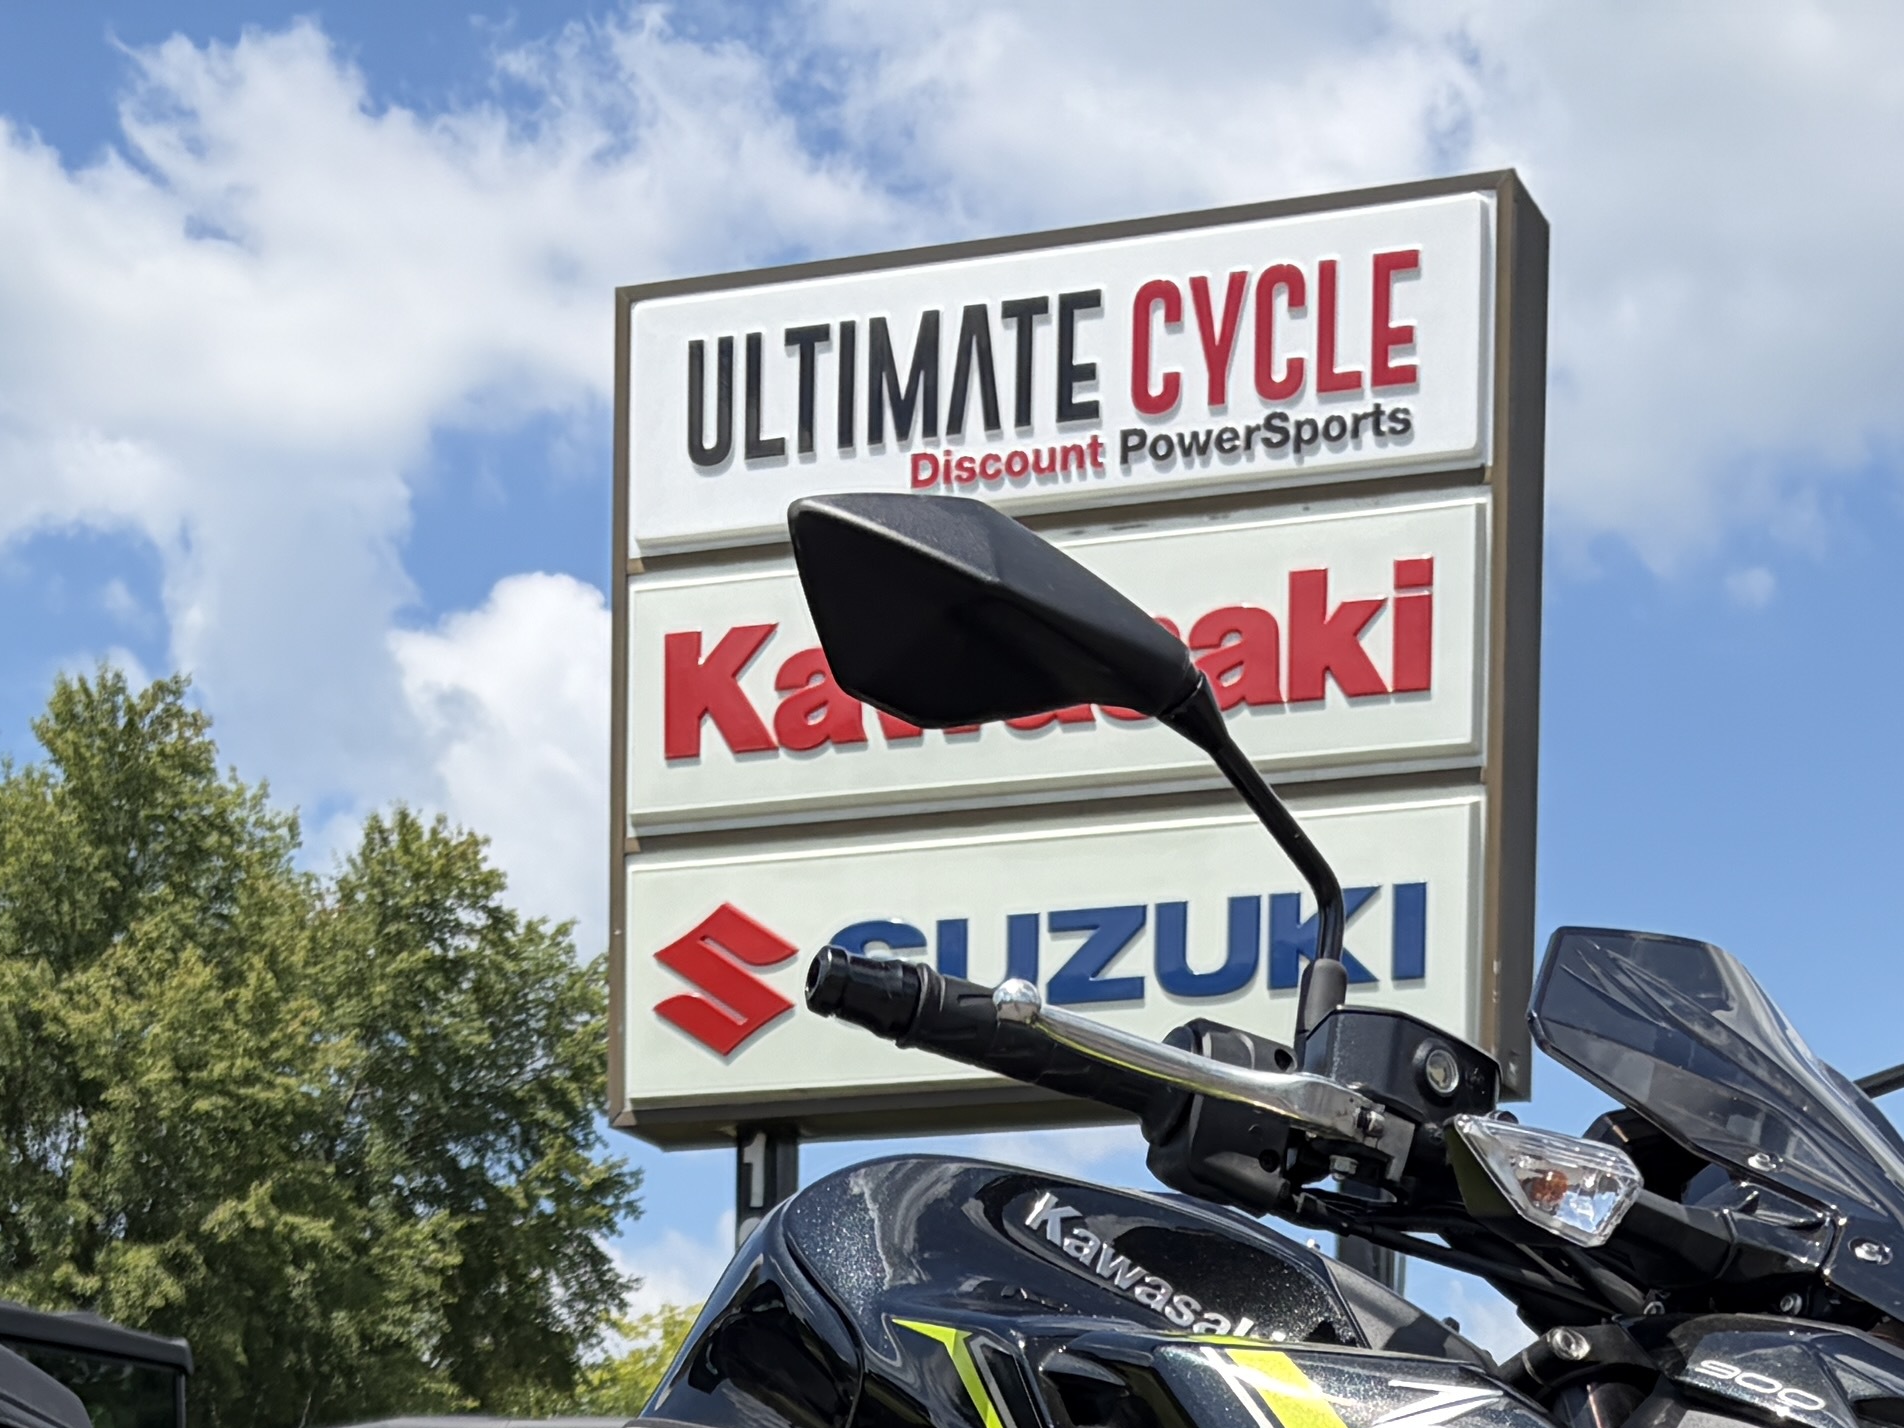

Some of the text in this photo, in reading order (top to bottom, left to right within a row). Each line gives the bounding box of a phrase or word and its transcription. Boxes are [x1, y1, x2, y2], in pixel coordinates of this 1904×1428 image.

[688, 250, 1420, 467] ULTIMATE CYCLE
[910, 403, 1413, 490] Discount PowerSports
[664, 555, 1434, 761] Kaaki
[1695, 1359, 1826, 1411] 900
